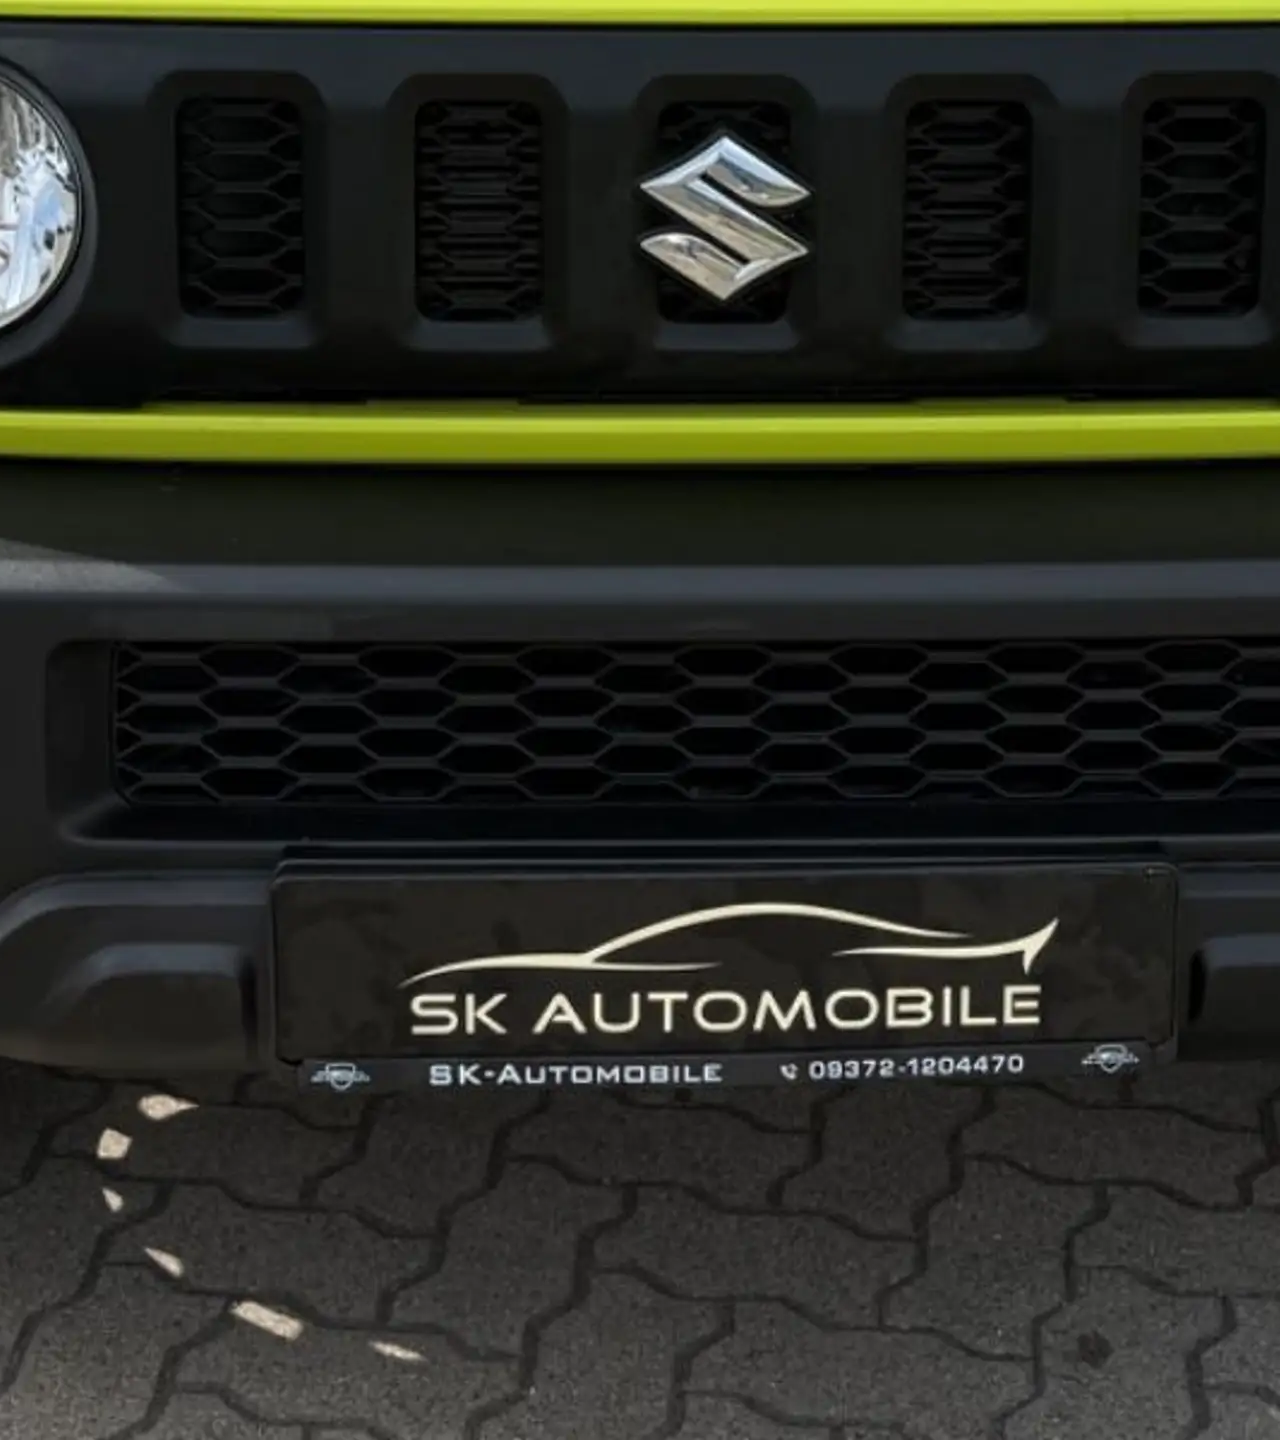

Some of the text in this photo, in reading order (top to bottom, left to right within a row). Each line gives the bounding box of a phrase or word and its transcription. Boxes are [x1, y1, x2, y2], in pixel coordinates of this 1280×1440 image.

[410, 985, 1042, 1035] SK AUTOMOBILE
[429, 1054, 1025, 1085] SK-AUTOMOBILE 09372-1204470
